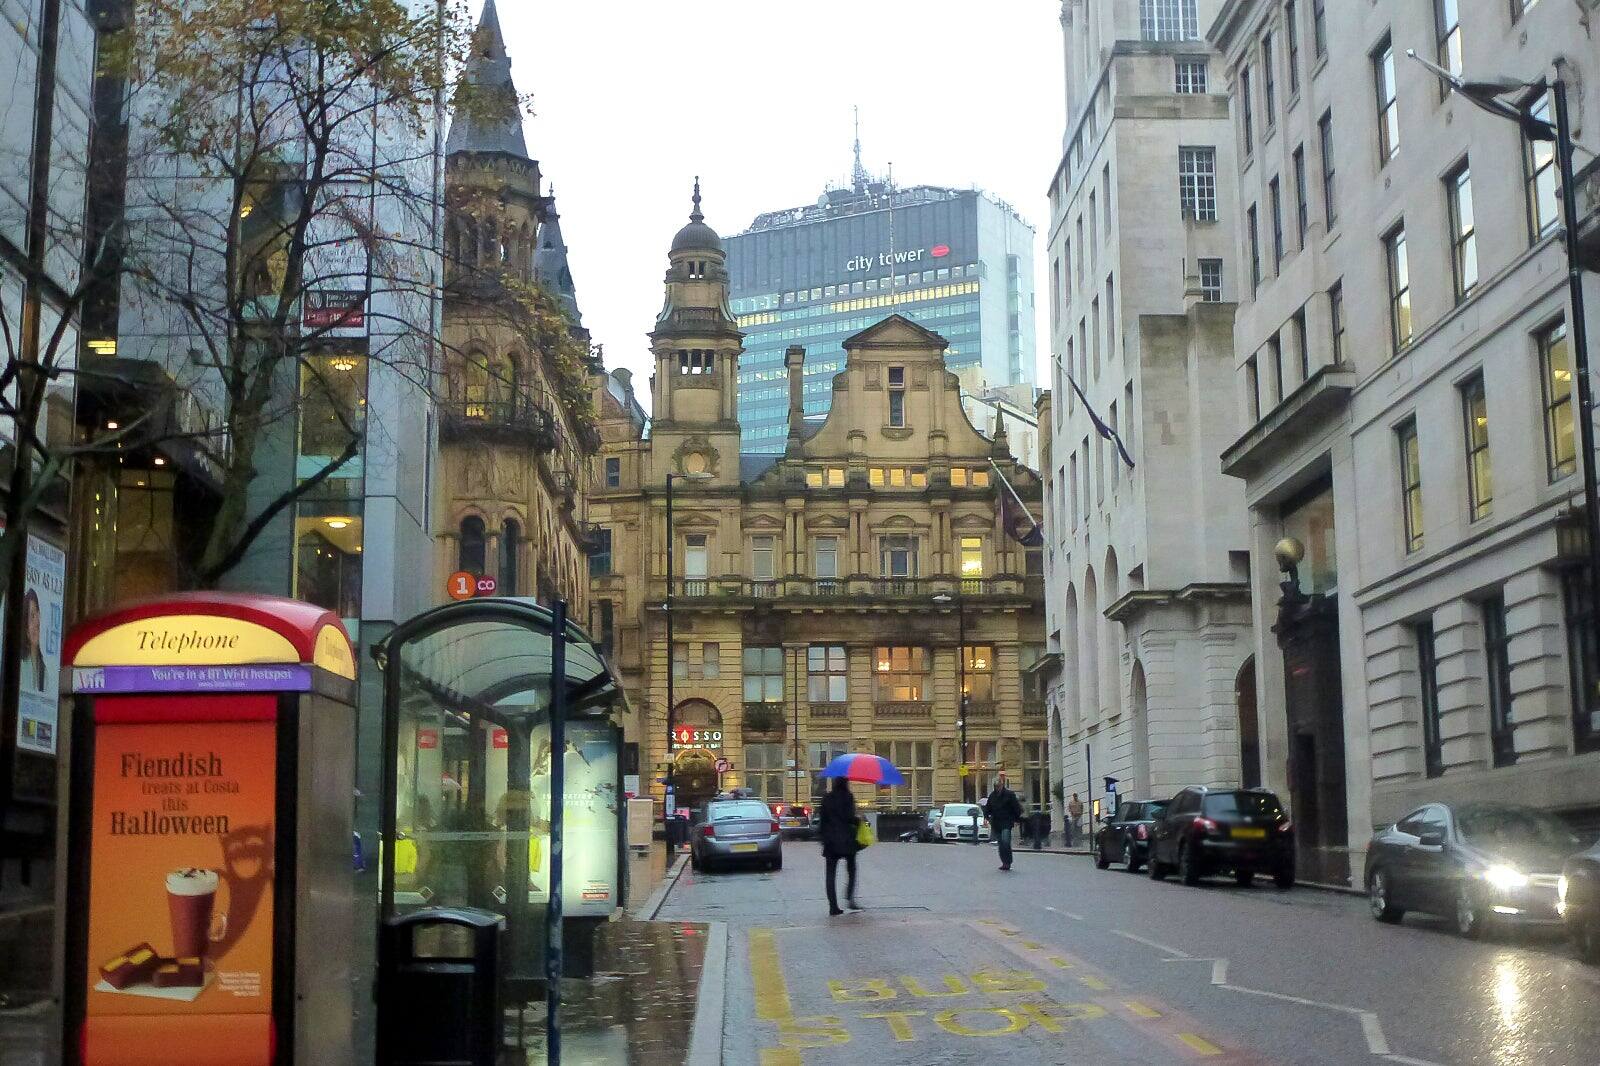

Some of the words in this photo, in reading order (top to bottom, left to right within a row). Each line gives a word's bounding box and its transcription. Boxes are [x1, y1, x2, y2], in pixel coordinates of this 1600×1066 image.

[846, 256, 873, 272] city
[879, 249, 924, 265] tower
[456, 577, 469, 594] 1
[136, 630, 240, 654] Telephone
[186, 668, 197, 680] in
[250, 669, 293, 681] hotspot
[672, 730, 721, 743] ROSSO
[120, 751, 223, 778] Fiendish
[141, 781, 182, 796] treats
[186, 781, 200, 795] at
[203, 779, 240, 794] Costa
[161, 797, 189, 812] this
[110, 808, 230, 836] Halloween
[827, 971, 1046, 1002] BUS
[778, 1002, 1106, 1049] STOP
